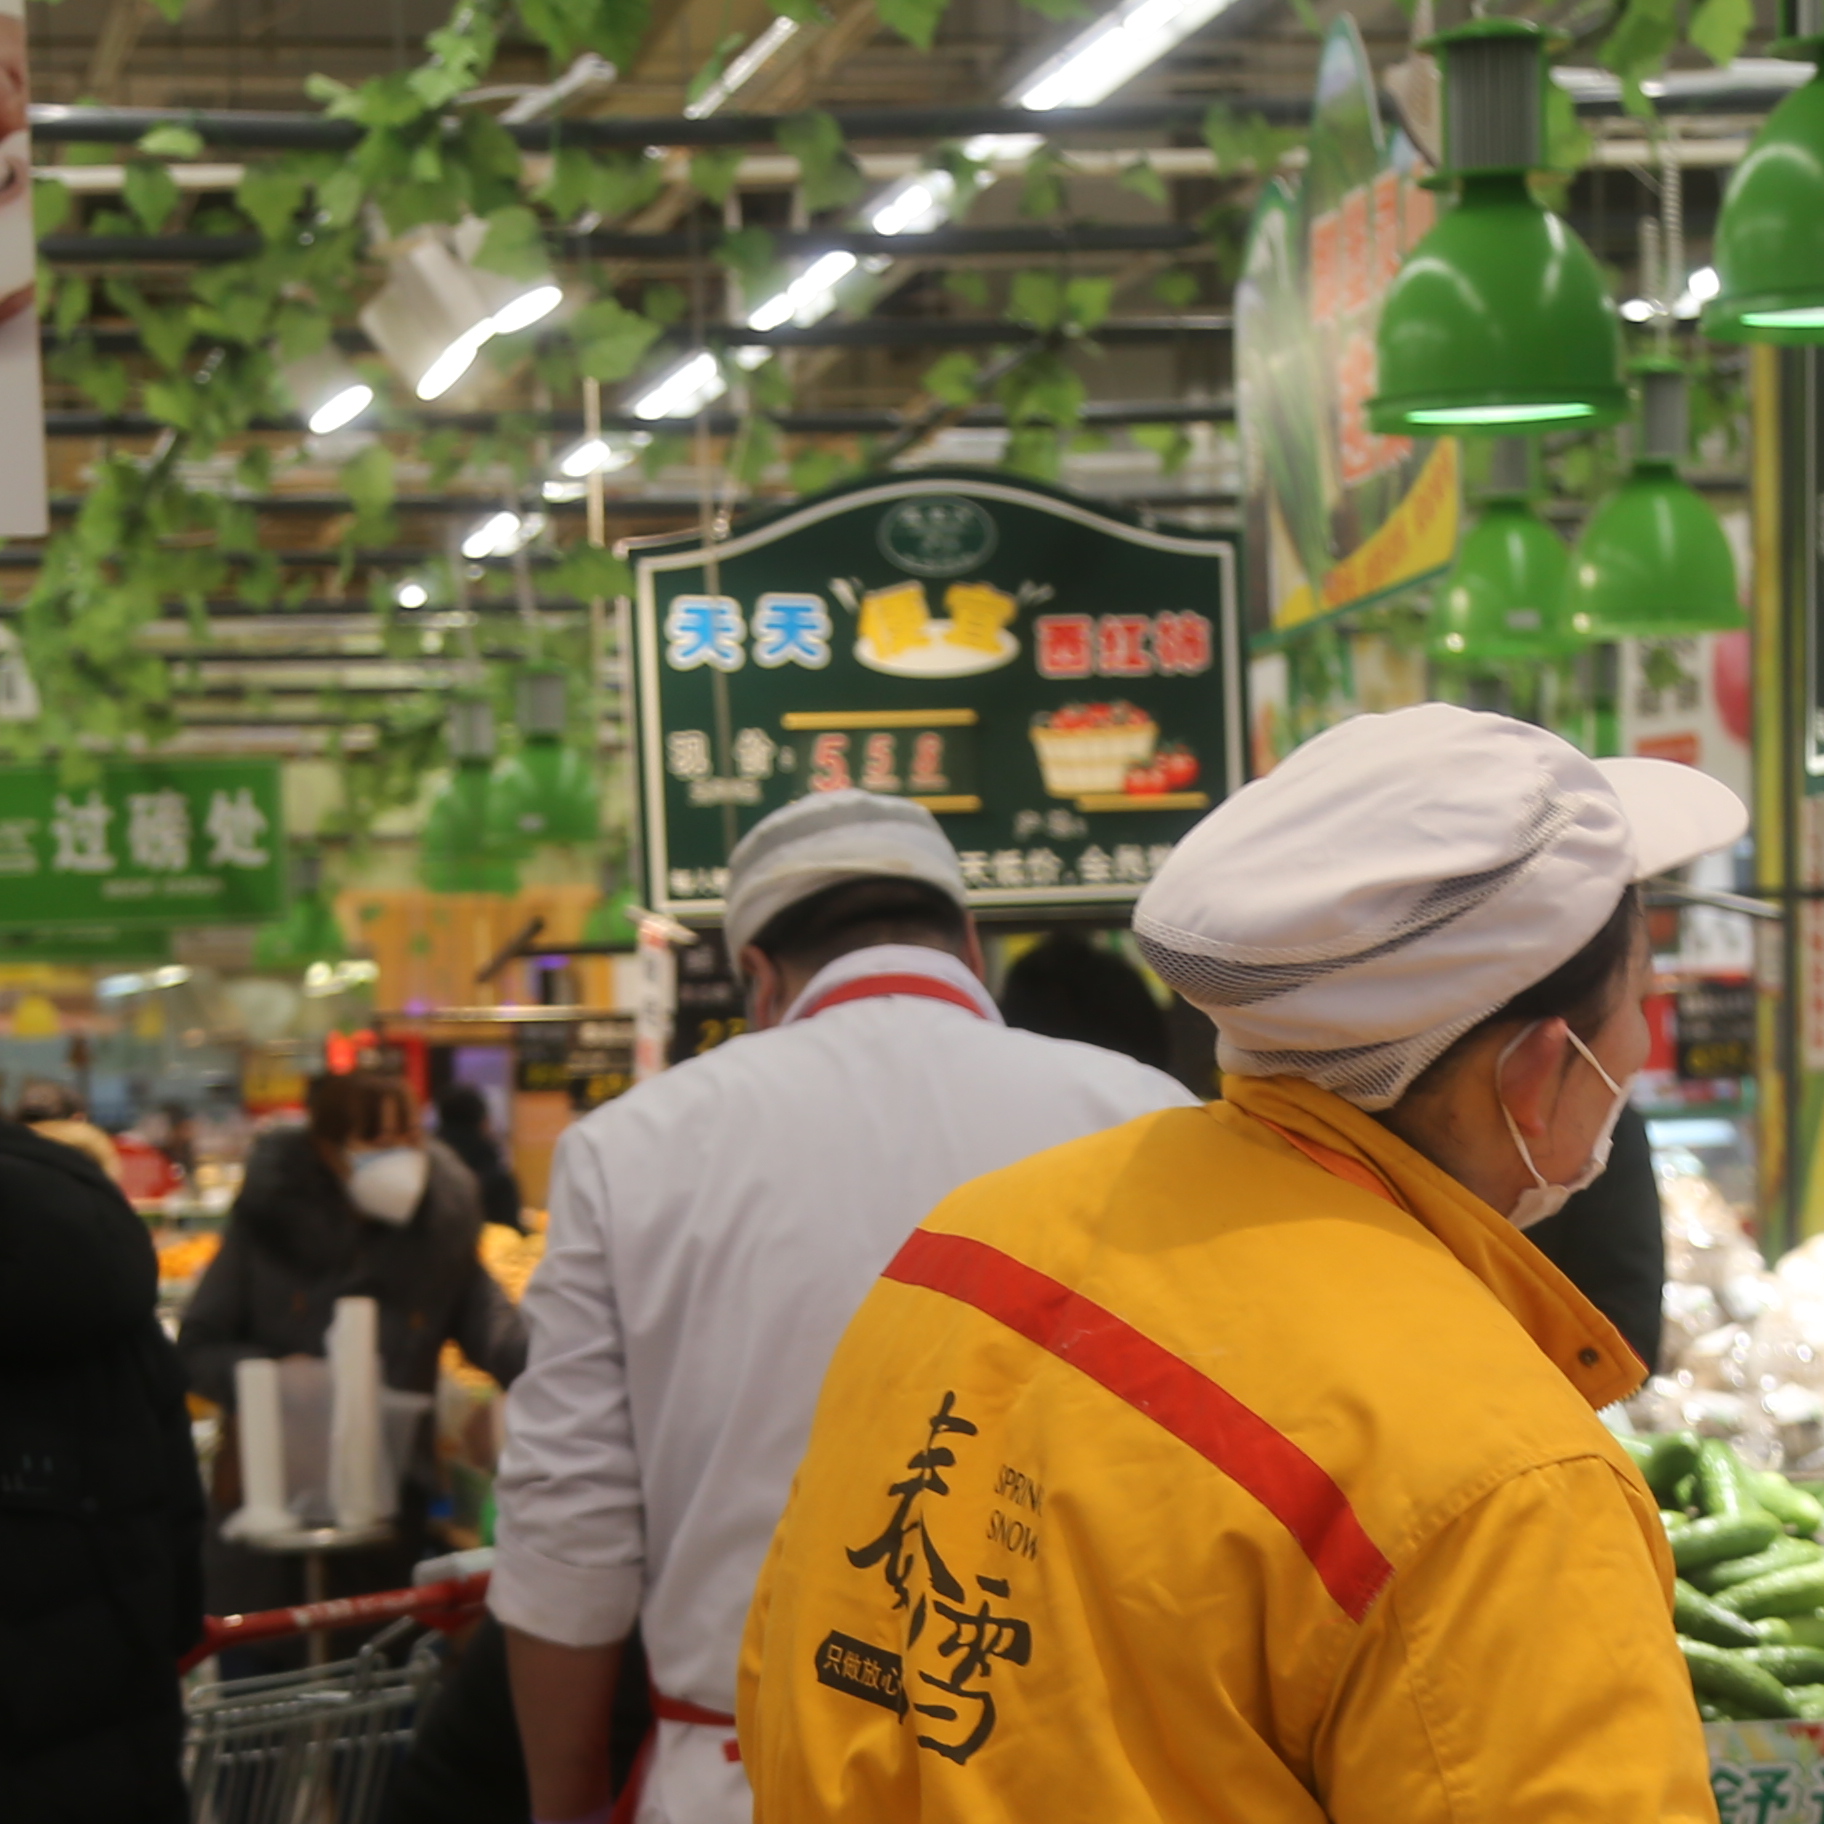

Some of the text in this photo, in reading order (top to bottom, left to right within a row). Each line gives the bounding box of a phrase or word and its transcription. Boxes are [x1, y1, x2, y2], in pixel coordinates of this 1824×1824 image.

[666, 594, 832, 672] 天天
[986, 1508, 1039, 1562] SNOW
[845, 1390, 1032, 1766] 春雪
